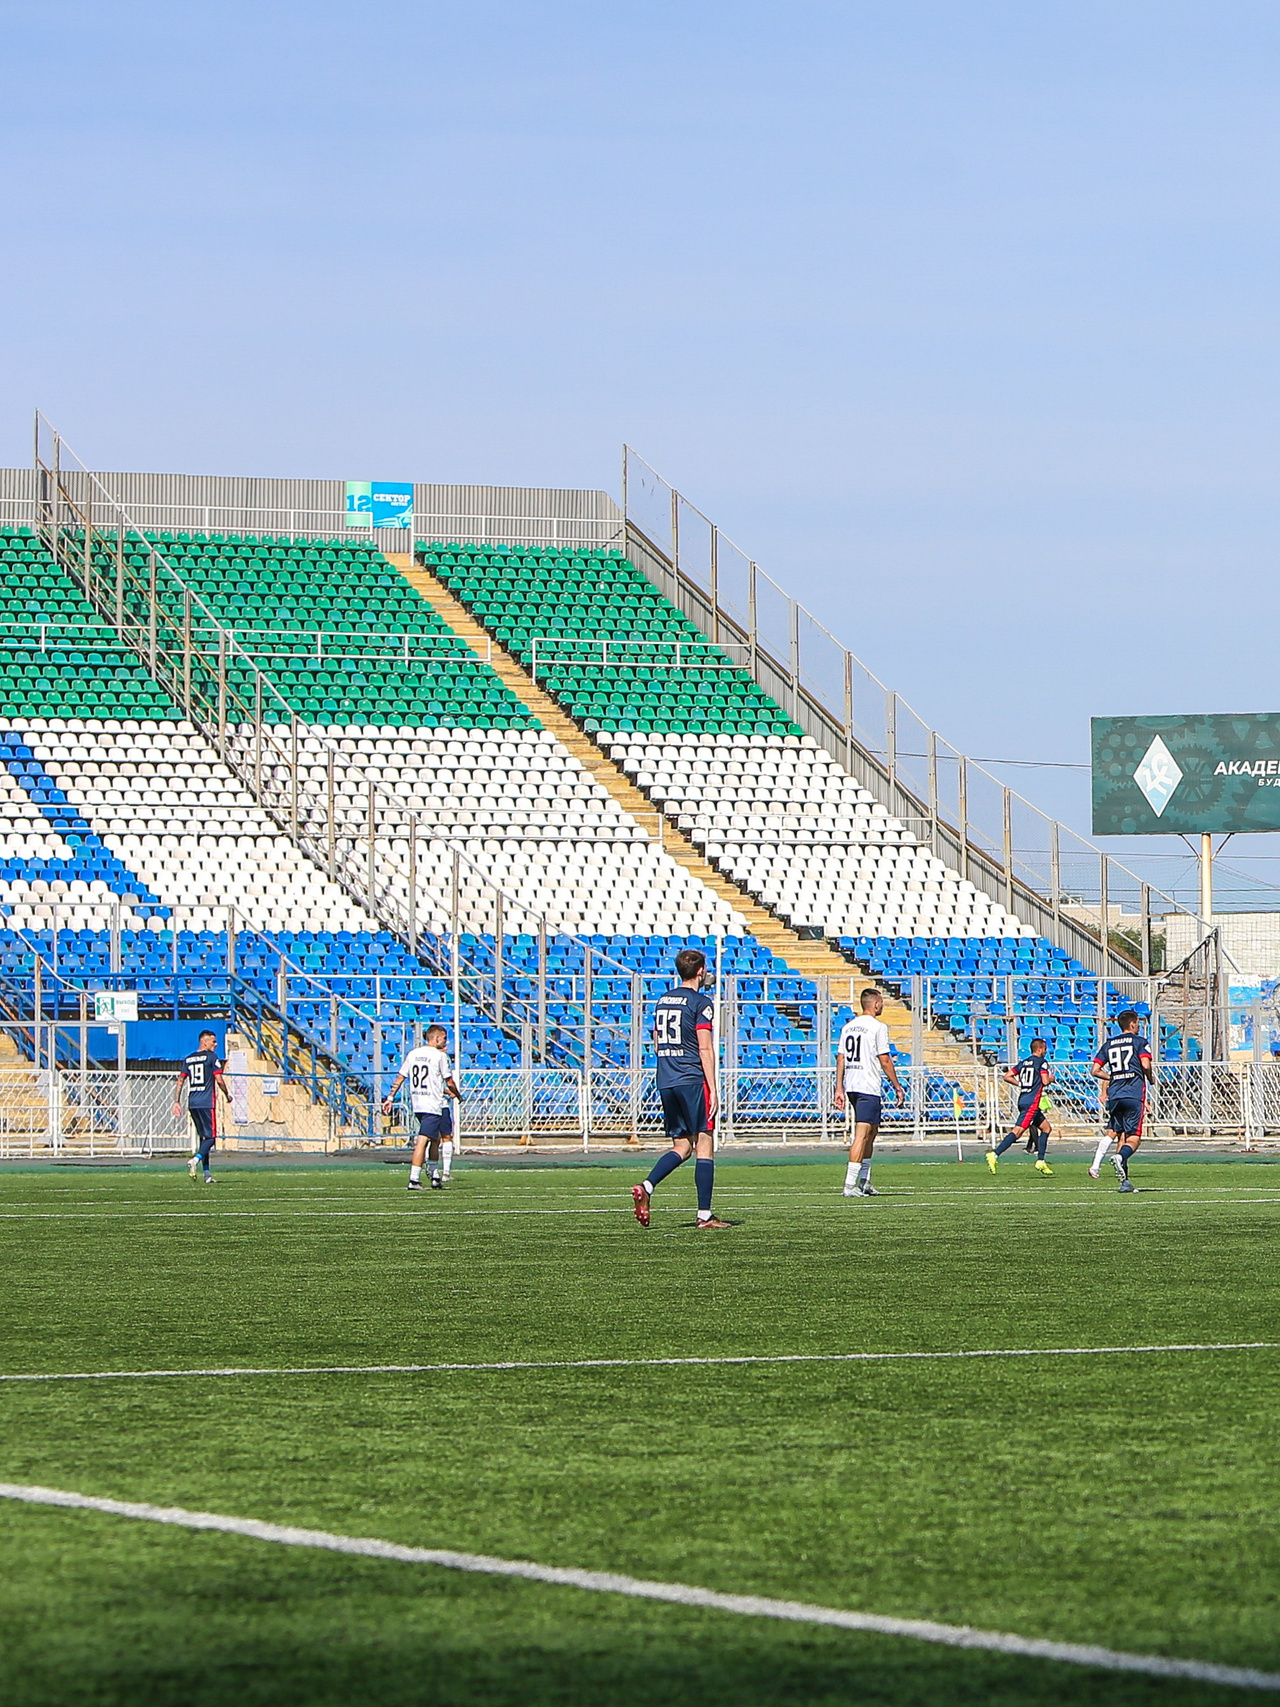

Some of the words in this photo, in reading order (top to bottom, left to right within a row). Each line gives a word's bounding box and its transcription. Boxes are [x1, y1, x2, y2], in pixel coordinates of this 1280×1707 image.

[346, 494, 371, 512] 12
[373, 493, 411, 503] СЕКТОР
[656, 1009, 682, 1044] 93
[845, 1035, 861, 1062] 91
[1108, 1045, 1134, 1073] 97
[188, 1063, 204, 1085] 19
[412, 1064, 429, 1089] 82
